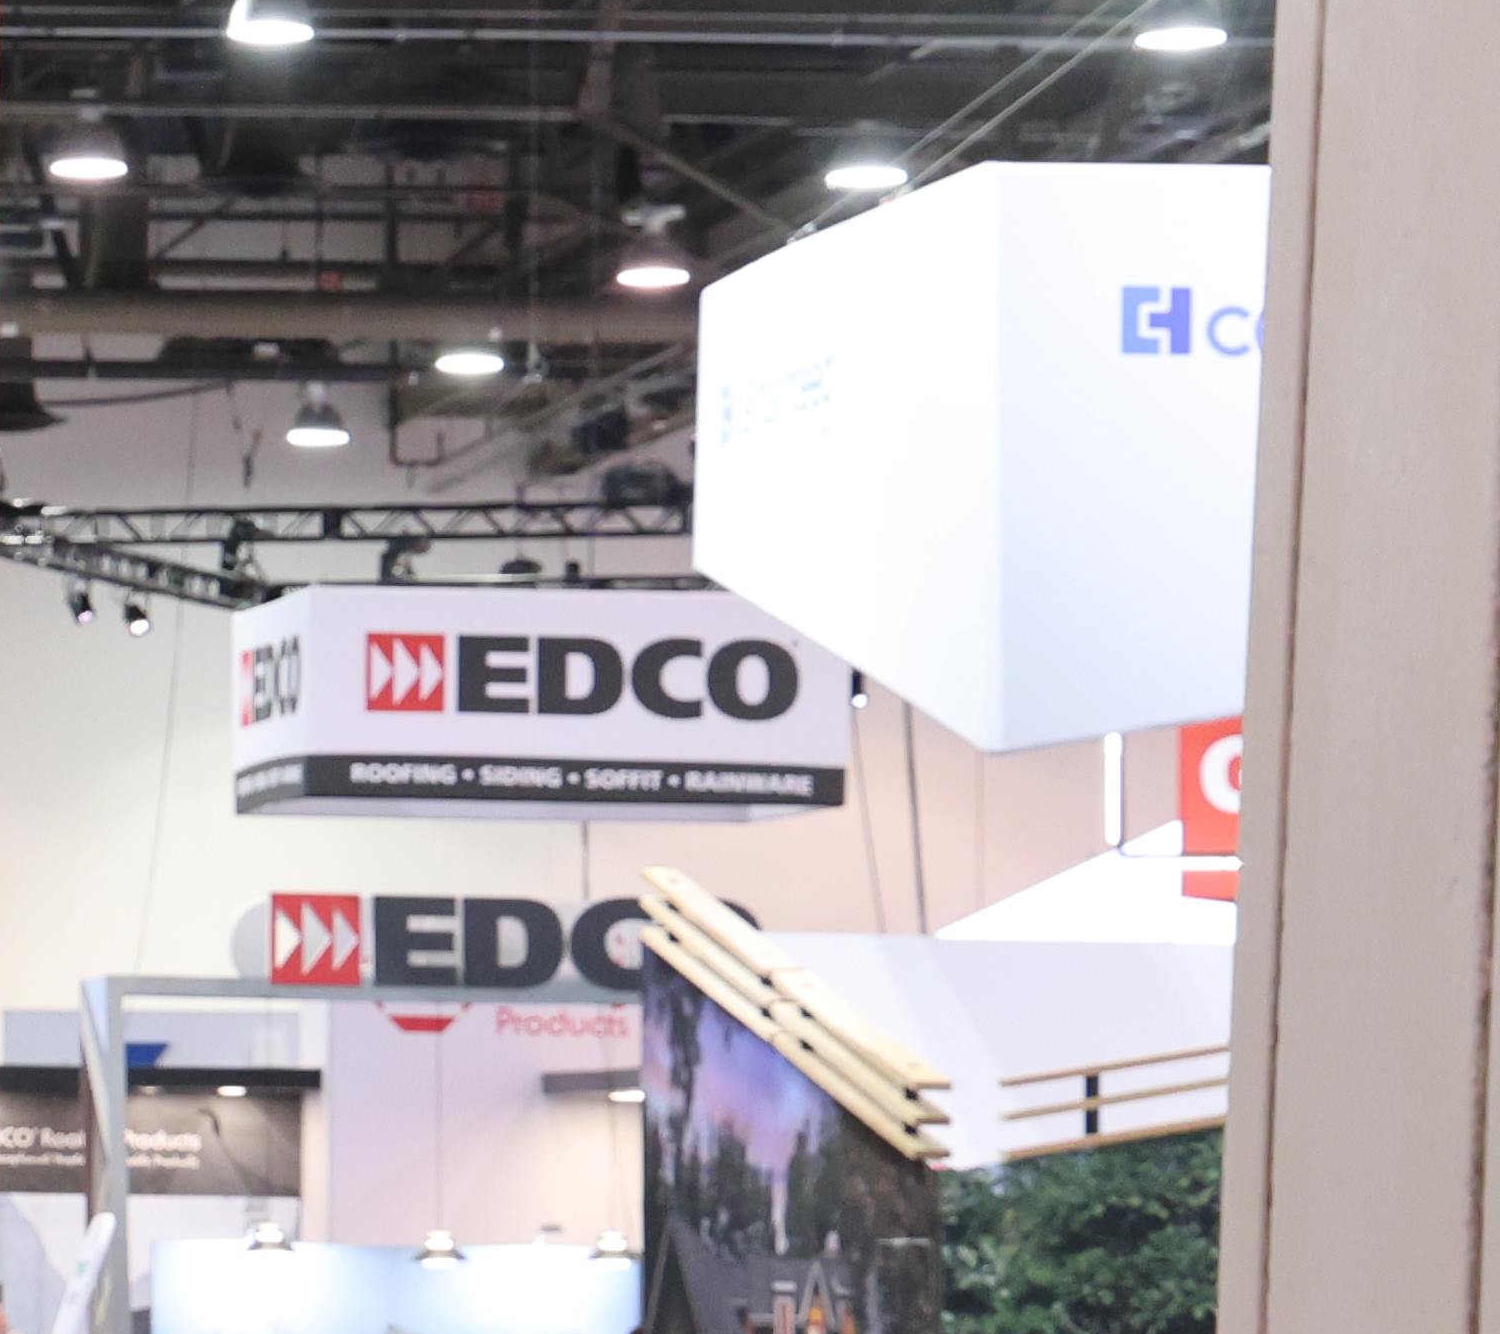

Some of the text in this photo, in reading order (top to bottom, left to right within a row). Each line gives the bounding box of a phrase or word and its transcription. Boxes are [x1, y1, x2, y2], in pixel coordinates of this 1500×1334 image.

[457, 634, 799, 721] EDCO
[350, 763, 815, 797] ROOFING SIDING SOFFIT RAINWARE
[374, 896, 762, 988] EDC
[495, 1005, 629, 1039] Products
